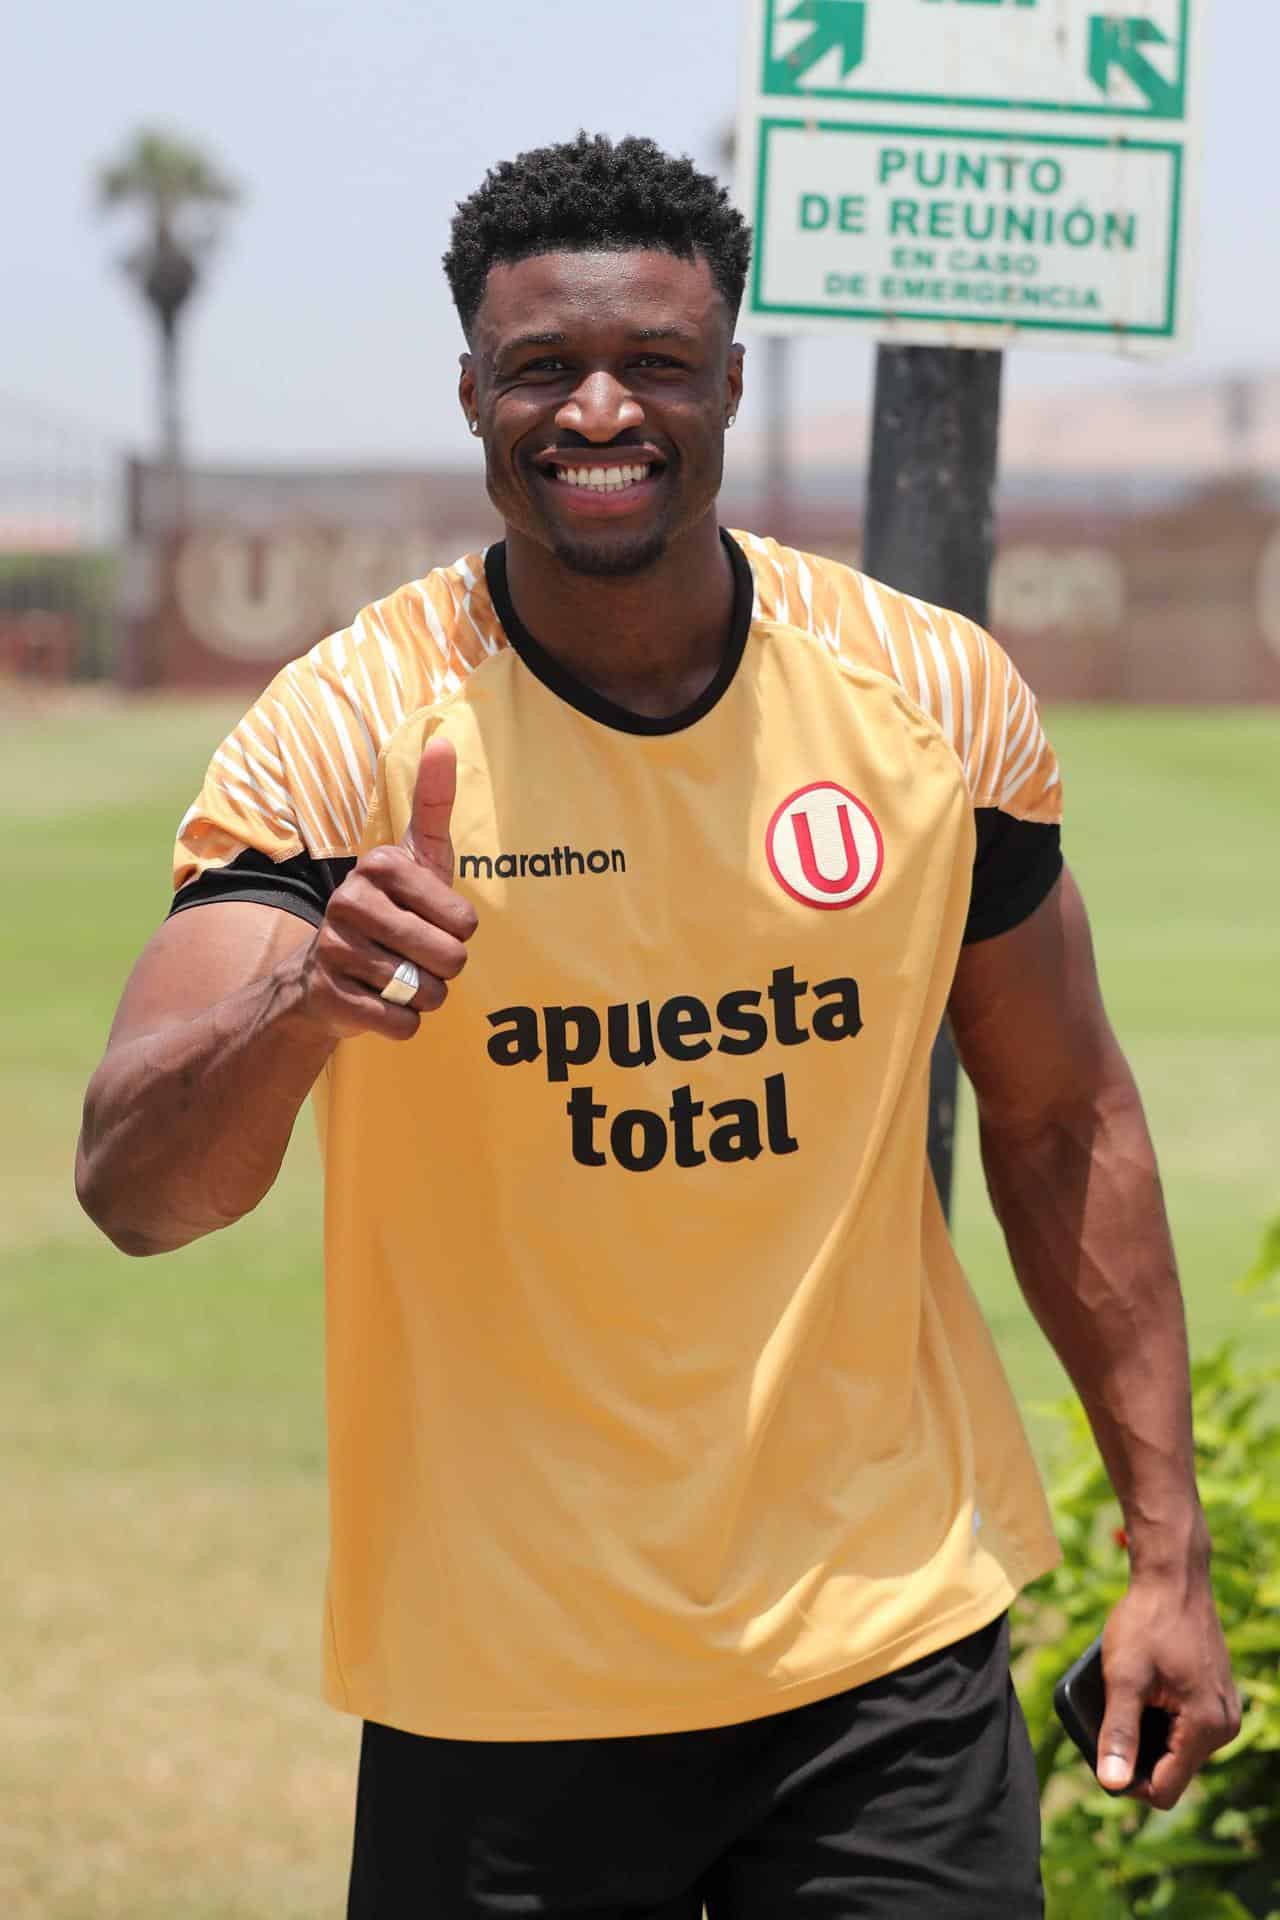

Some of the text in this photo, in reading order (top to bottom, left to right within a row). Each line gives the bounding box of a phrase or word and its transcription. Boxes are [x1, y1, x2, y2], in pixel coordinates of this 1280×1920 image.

[878, 148, 1063, 195] PUNTO
[799, 194, 1136, 250] DE REUNIÓN
[892, 248, 1039, 277] EN CASO
[824, 274, 1101, 310] DE EMERGENCIA
[459, 846, 626, 879] marathon
[790, 804, 861, 895] U
[486, 966, 864, 1082] apuesta
[566, 1072, 799, 1172] total
